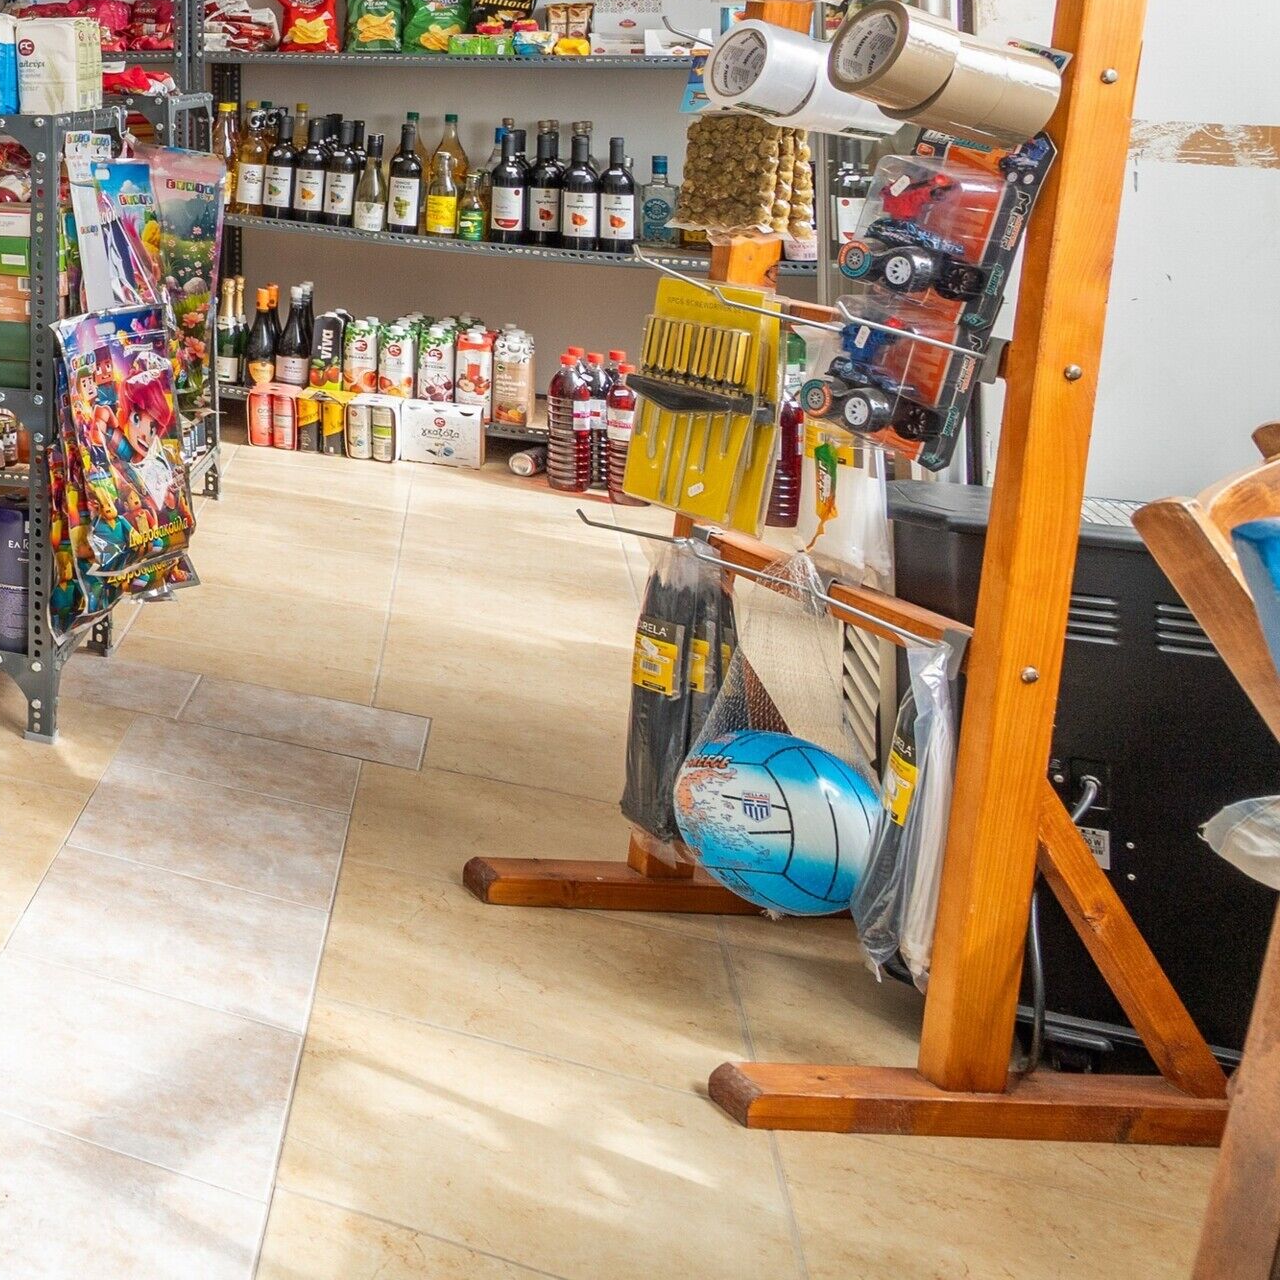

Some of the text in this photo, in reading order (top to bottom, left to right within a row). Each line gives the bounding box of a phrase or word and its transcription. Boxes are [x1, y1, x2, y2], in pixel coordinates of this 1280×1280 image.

[320, 329, 335, 360] viva
[421, 425, 460, 440] γκαζόζα
[742, 791, 770, 799] HELLAS
